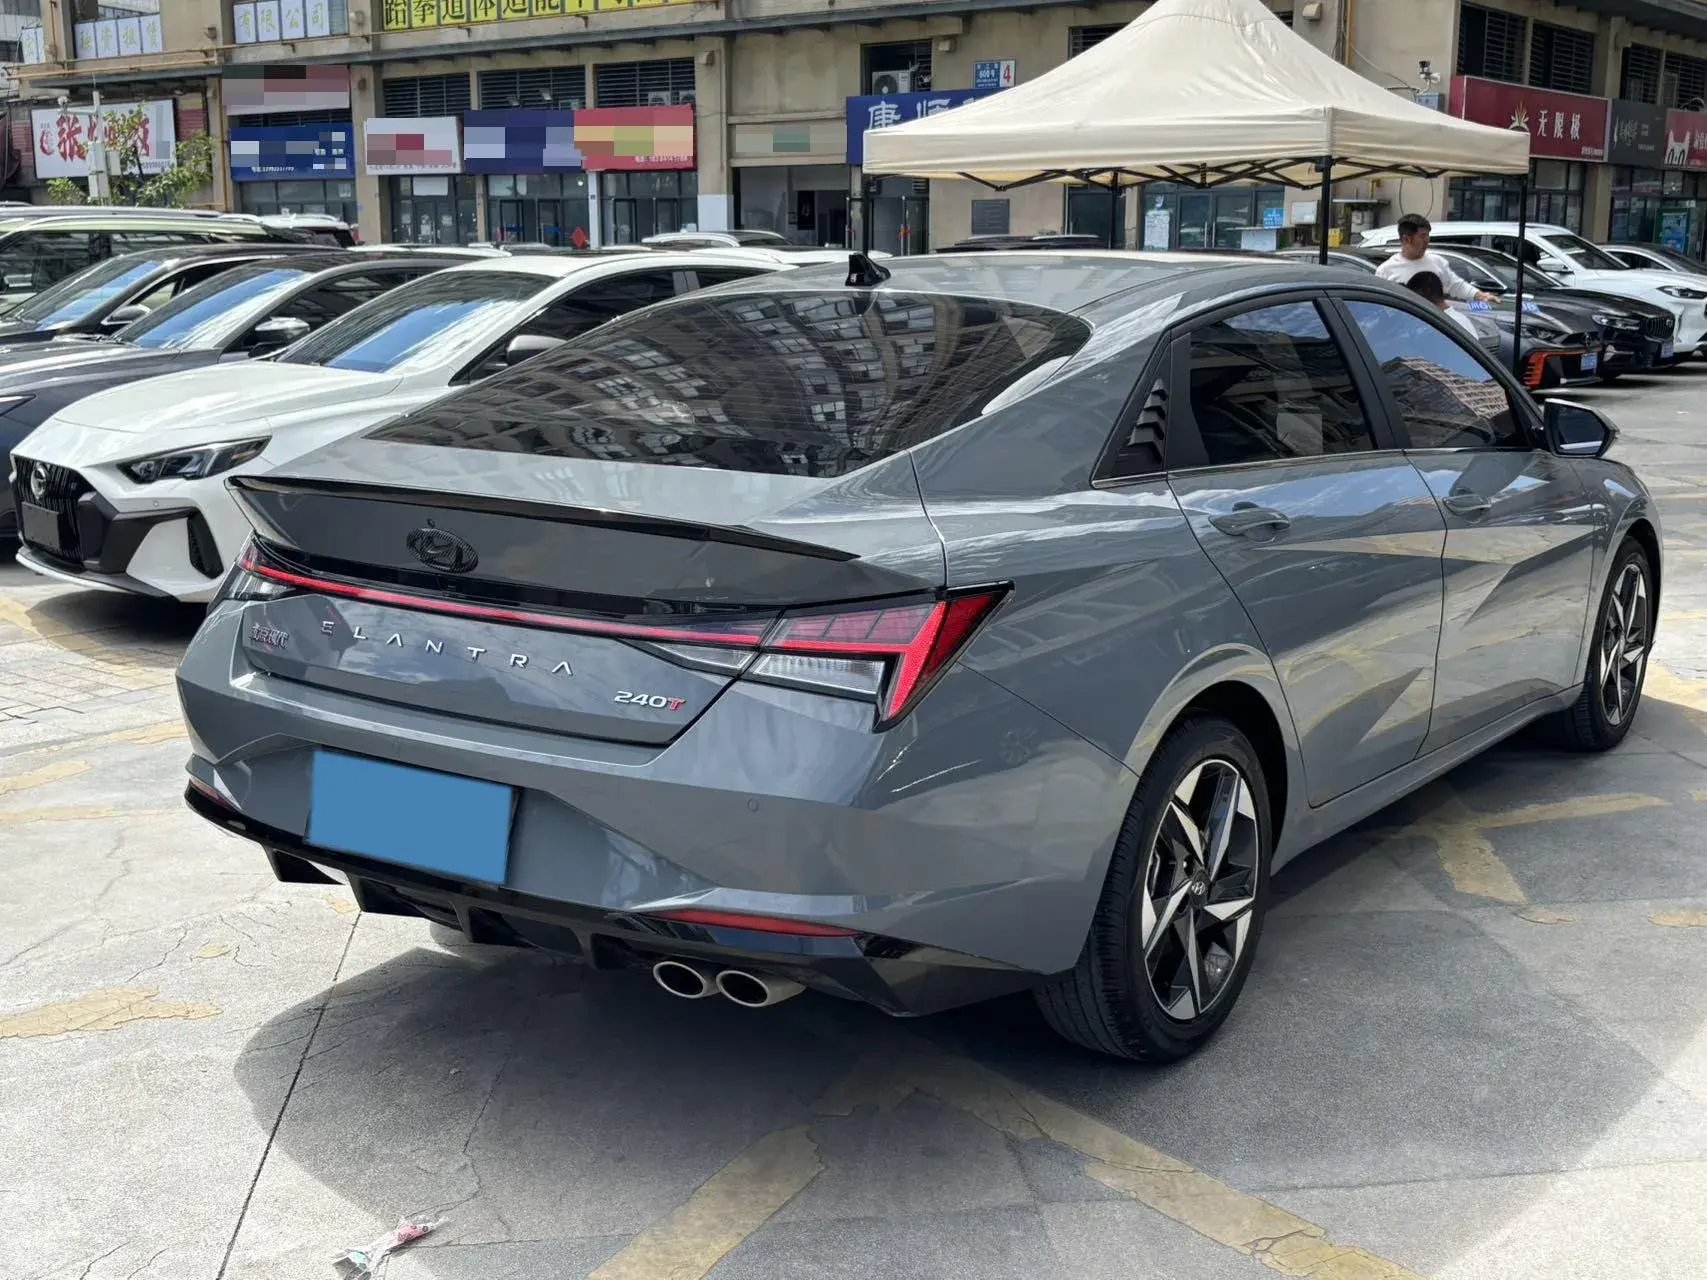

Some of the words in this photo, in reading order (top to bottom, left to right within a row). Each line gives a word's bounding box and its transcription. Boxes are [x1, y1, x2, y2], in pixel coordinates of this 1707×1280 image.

[1003, 64, 1012, 83] 4
[321, 620, 574, 677] ELANTRA
[613, 690, 687, 711] 240T
